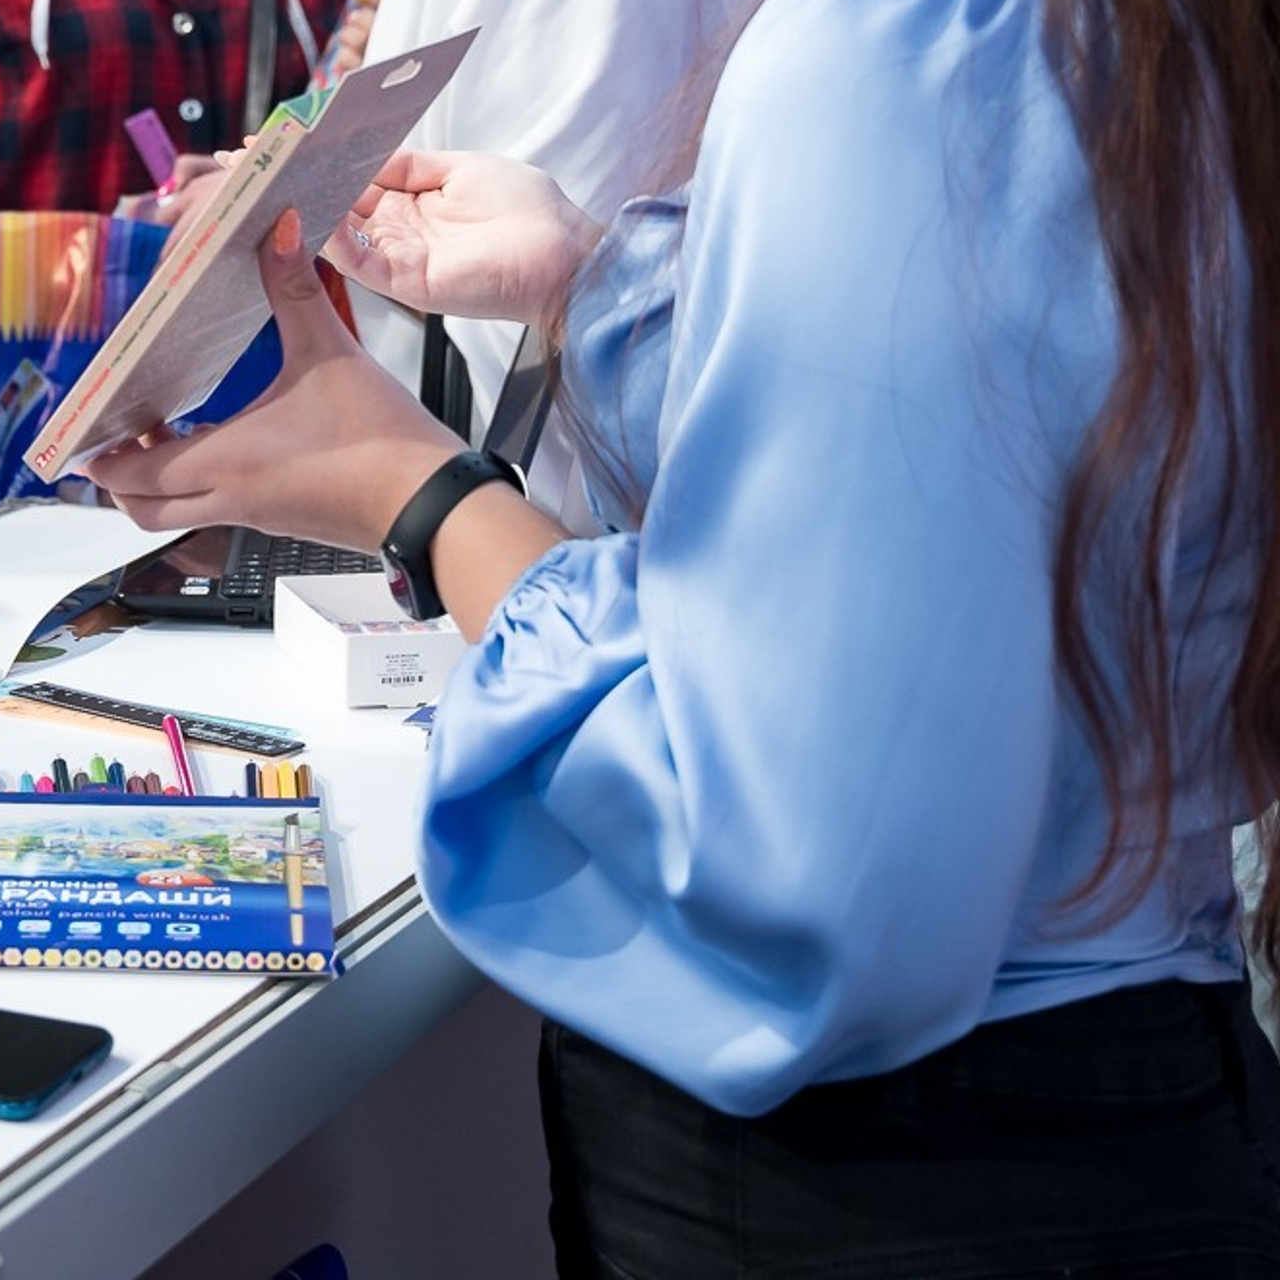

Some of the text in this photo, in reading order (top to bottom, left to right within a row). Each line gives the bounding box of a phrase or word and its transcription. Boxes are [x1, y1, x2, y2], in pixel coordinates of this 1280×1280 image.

[148, 874, 184, 886] 24
[57, 910, 127, 920] pencils
[133, 911, 172, 919] with
[178, 911, 231, 921] brush
